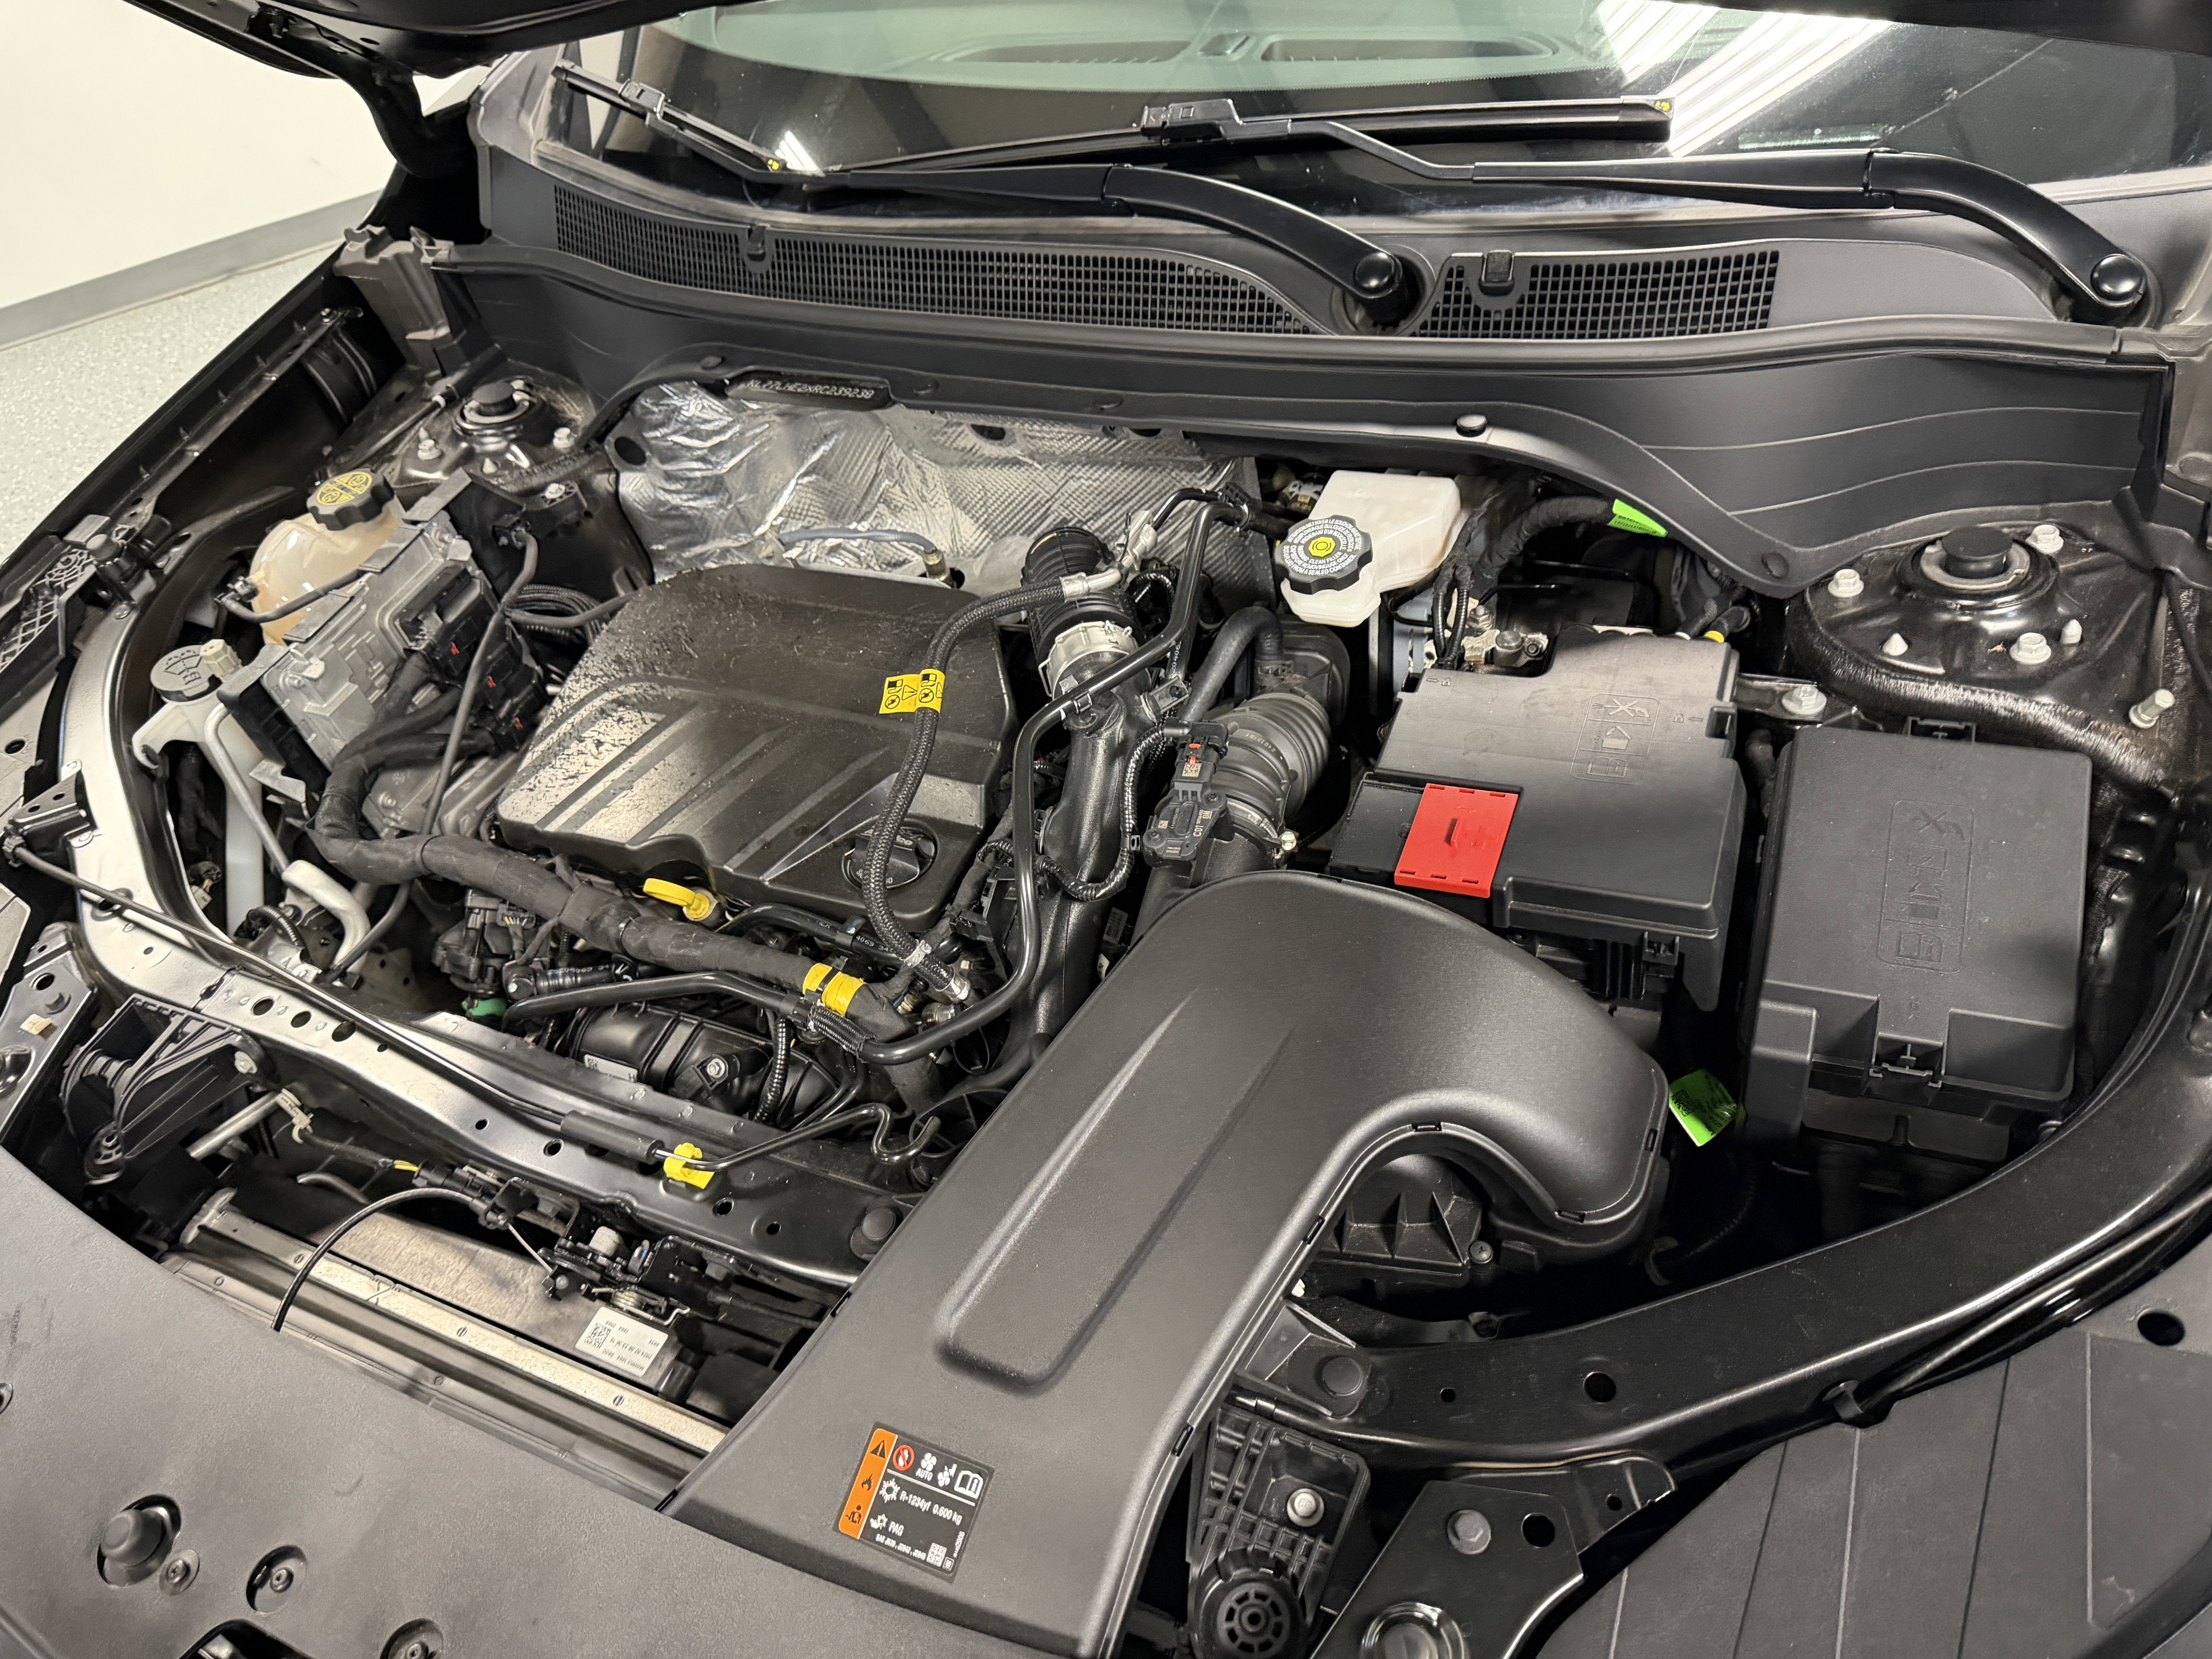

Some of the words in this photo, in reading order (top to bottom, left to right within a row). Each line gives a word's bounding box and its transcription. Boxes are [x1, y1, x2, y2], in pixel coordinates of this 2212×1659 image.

[1326, 551, 1343, 563] FILLER
[1336, 553, 1348, 563] ONLY
[1291, 563, 1305, 574] FROM
[1202, 811, 1212, 819] GM
[915, 1469, 933, 1481] AUTO
[900, 1492, 931, 1512] R-1234yf
[933, 1504, 953, 1520] 0.600
[953, 1513, 963, 1526] kg
[889, 1521, 904, 1537] PAG
